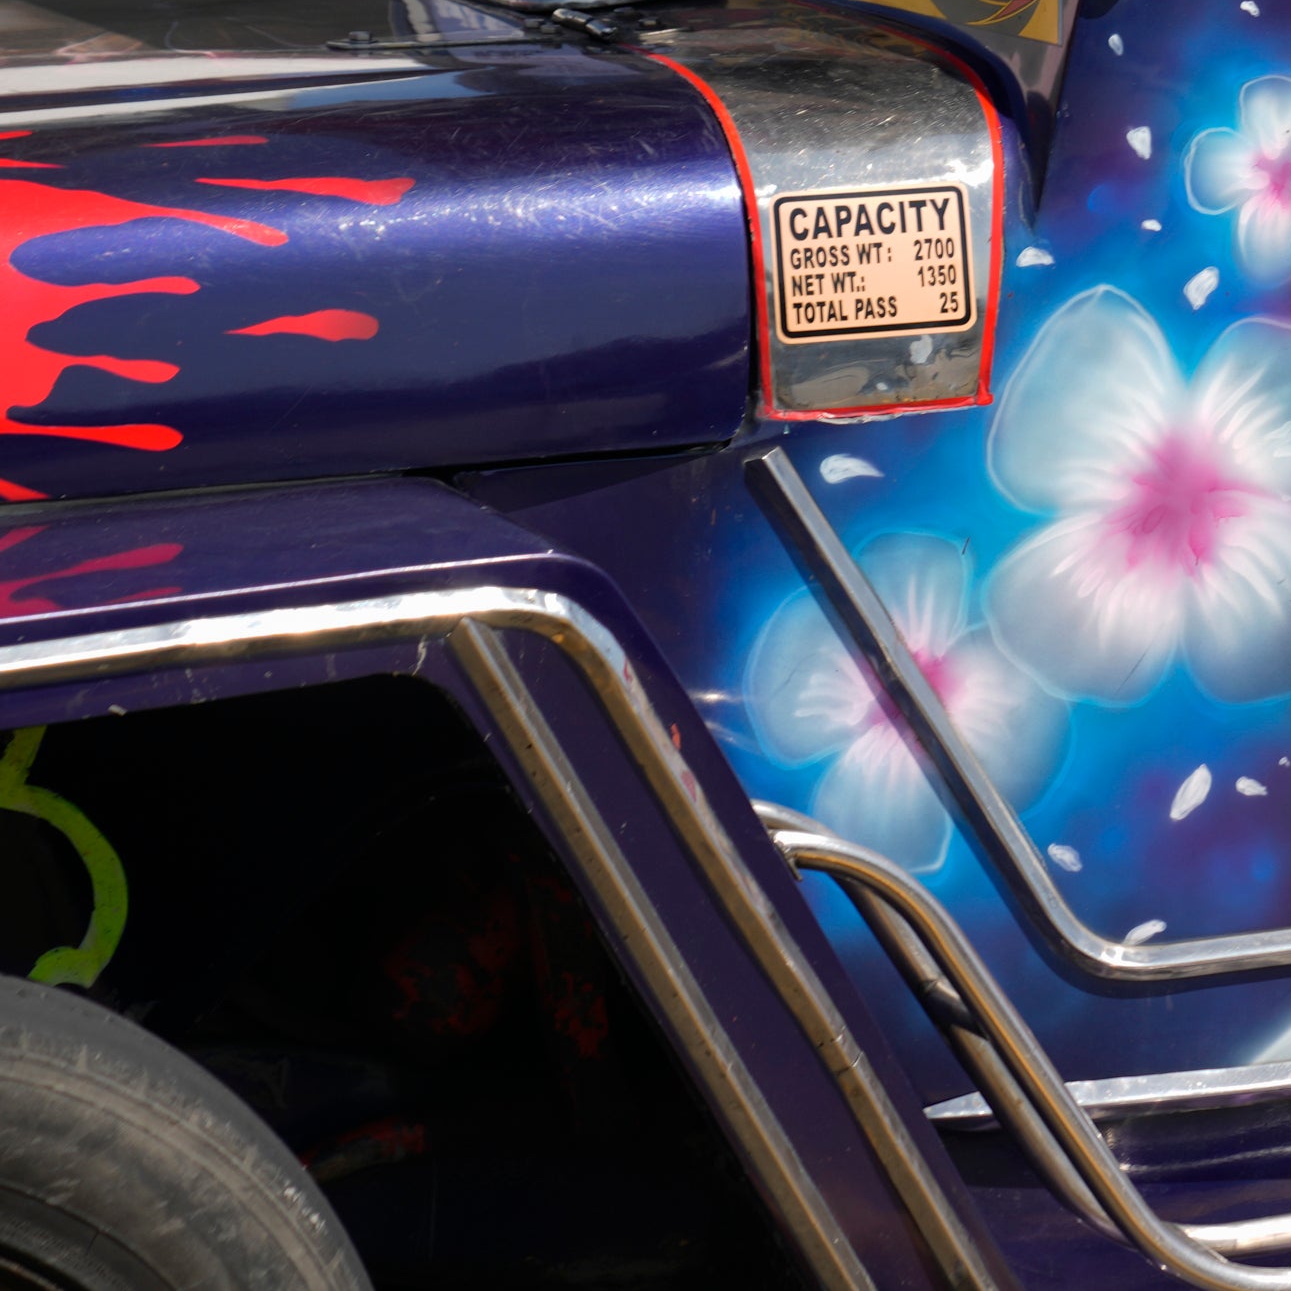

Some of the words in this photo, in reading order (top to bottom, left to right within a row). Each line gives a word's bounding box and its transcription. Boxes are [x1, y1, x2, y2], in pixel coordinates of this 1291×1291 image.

[789, 198, 950, 242] CAPACITY
[790, 244, 851, 270] GROSS
[914, 237, 955, 261] 2700
[792, 274, 825, 297] NET
[917, 264, 957, 287] 1350
[793, 299, 848, 324] TOTAL
[854, 296, 898, 320] PASS
[939, 291, 959, 314] 25
